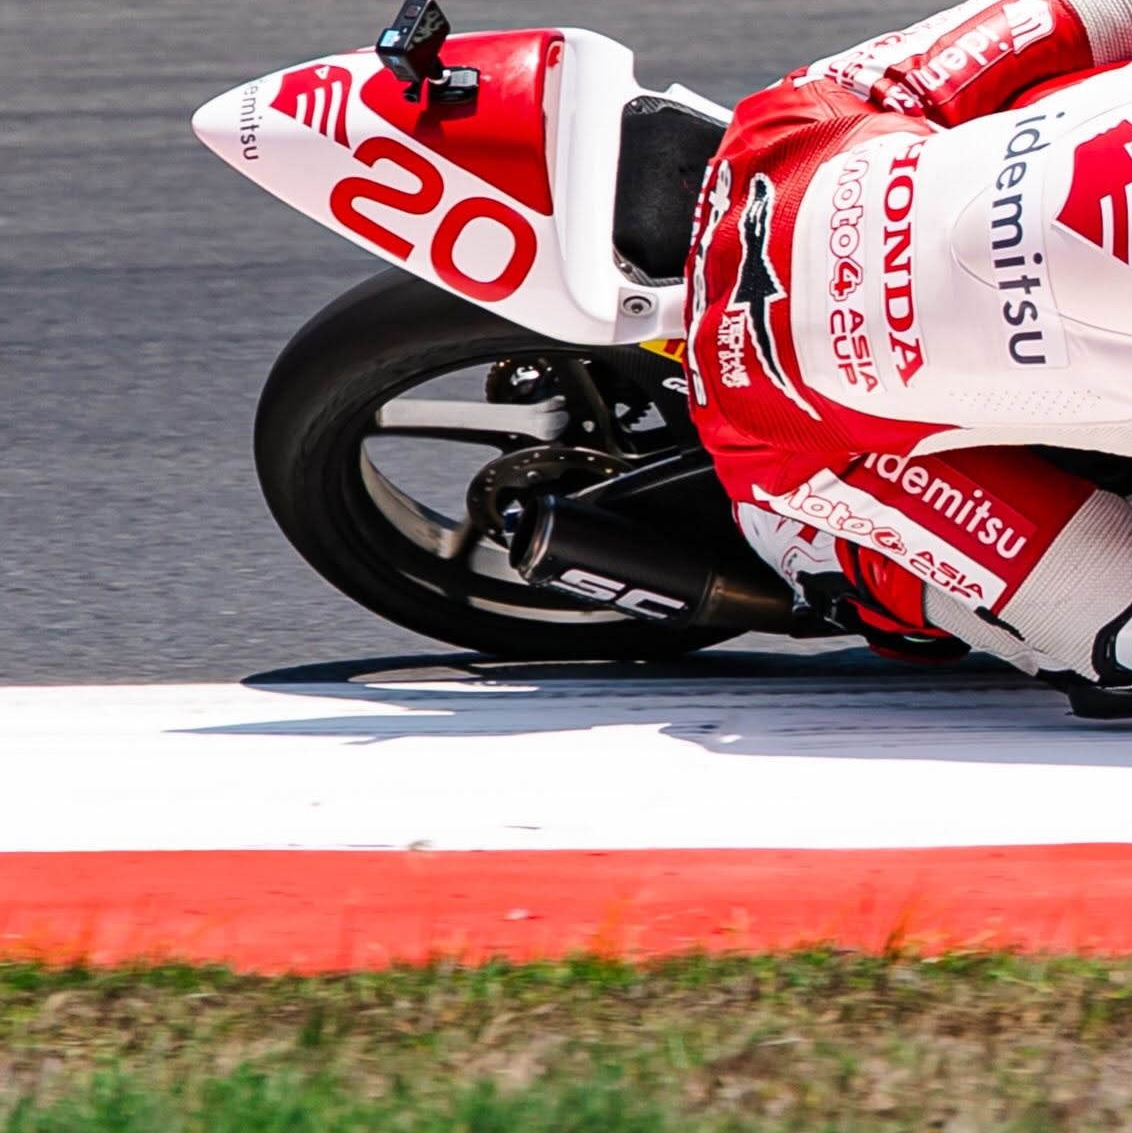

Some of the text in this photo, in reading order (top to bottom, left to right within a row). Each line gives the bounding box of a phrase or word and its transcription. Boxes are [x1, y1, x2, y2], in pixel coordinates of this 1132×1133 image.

[330, 137, 537, 302] 20
[991, 111, 1065, 366] idemitsu
[883, 139, 927, 388] HONDA
[829, 308, 857, 386] CUP
[849, 308, 878, 394] ASIA
[909, 557, 972, 600] CUP
[913, 550, 985, 600] ASIA
